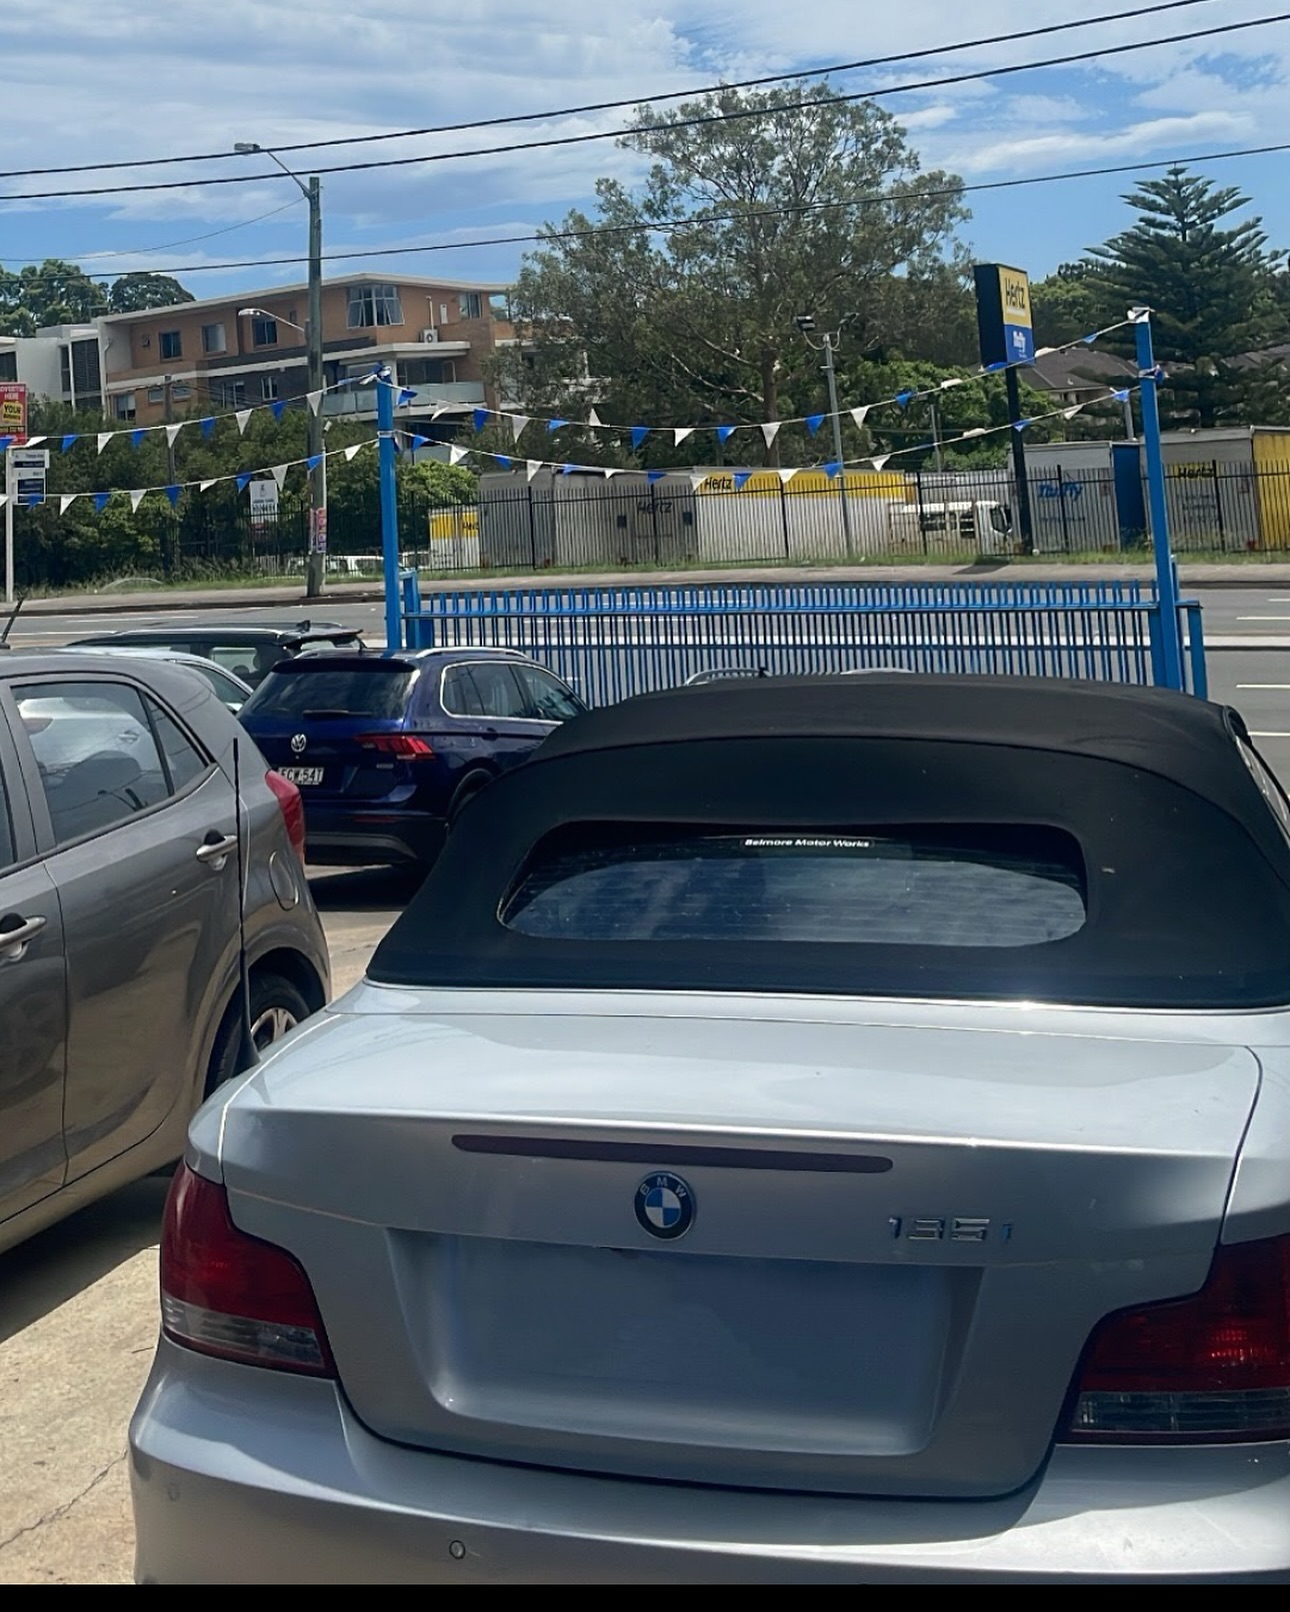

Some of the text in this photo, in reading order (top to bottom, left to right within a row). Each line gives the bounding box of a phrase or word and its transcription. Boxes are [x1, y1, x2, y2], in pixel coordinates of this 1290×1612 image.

[1005, 278, 1025, 309] Hertz
[704, 476, 732, 491] Hertz
[637, 500, 673, 515] Hertz
[795, 839, 831, 847] Motor
[833, 840, 869, 848] Works
[639, 1176, 688, 1198] BMW
